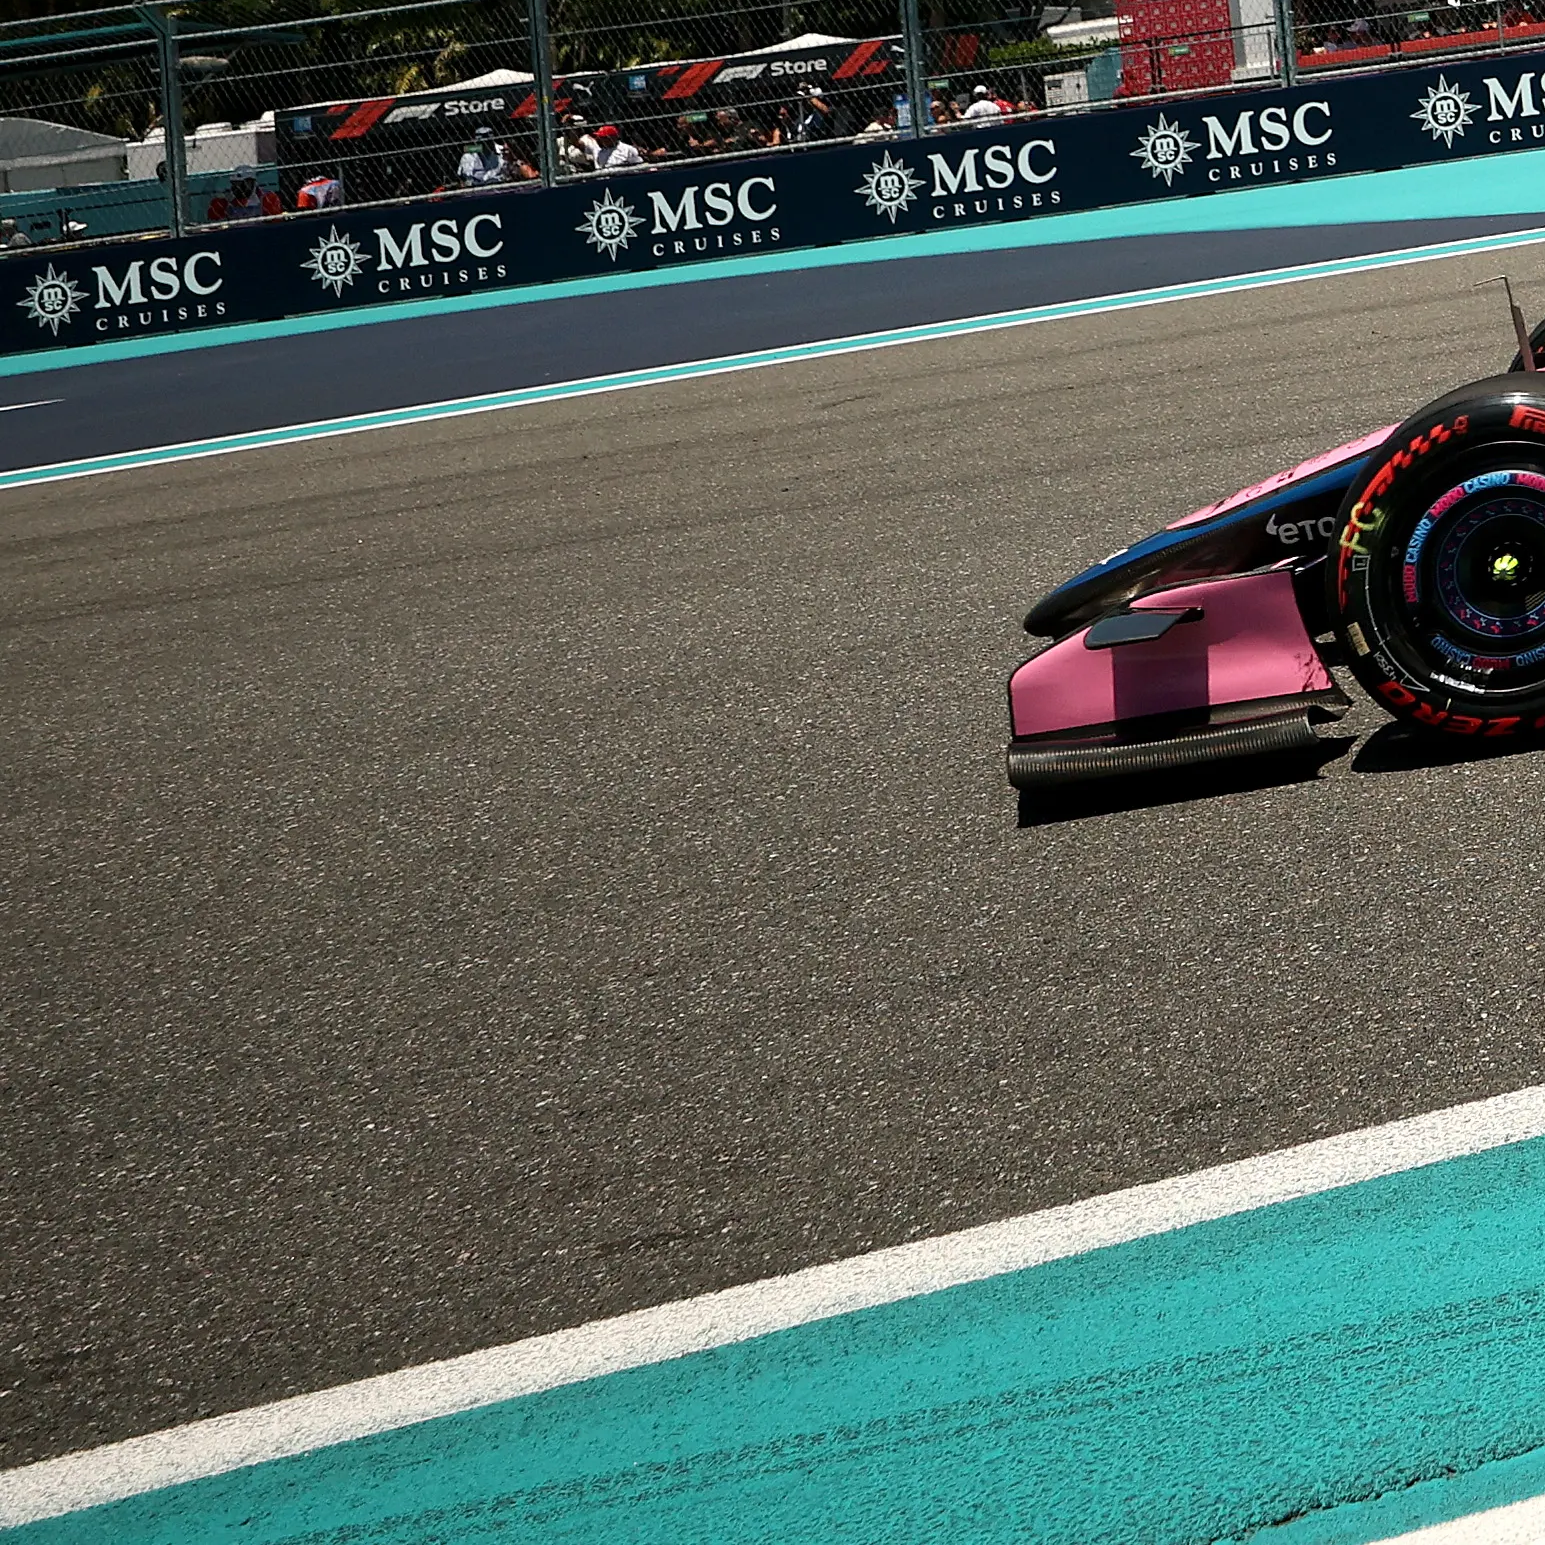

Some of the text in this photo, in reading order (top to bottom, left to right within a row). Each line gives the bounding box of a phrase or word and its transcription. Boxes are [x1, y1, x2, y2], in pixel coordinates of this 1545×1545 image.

[770, 57, 827, 77] Store
[444, 97, 505, 116] Store
[1202, 102, 1332, 159] MSC
[927, 140, 1057, 196] MSC
[1208, 152, 1337, 182] CRUISES
[648, 177, 776, 234] MSC
[932, 190, 1061, 219] CRUISES
[374, 214, 503, 271] MSC
[652, 227, 780, 257] CRUISES
[92, 252, 222, 308] MSC
[378, 264, 507, 294] CRUISES
[95, 301, 226, 331] CRUISES
[1463, 472, 1511, 494] CASINO
[1405, 519, 1432, 563] CASINO
[1378, 681, 1520, 737] ZERO
